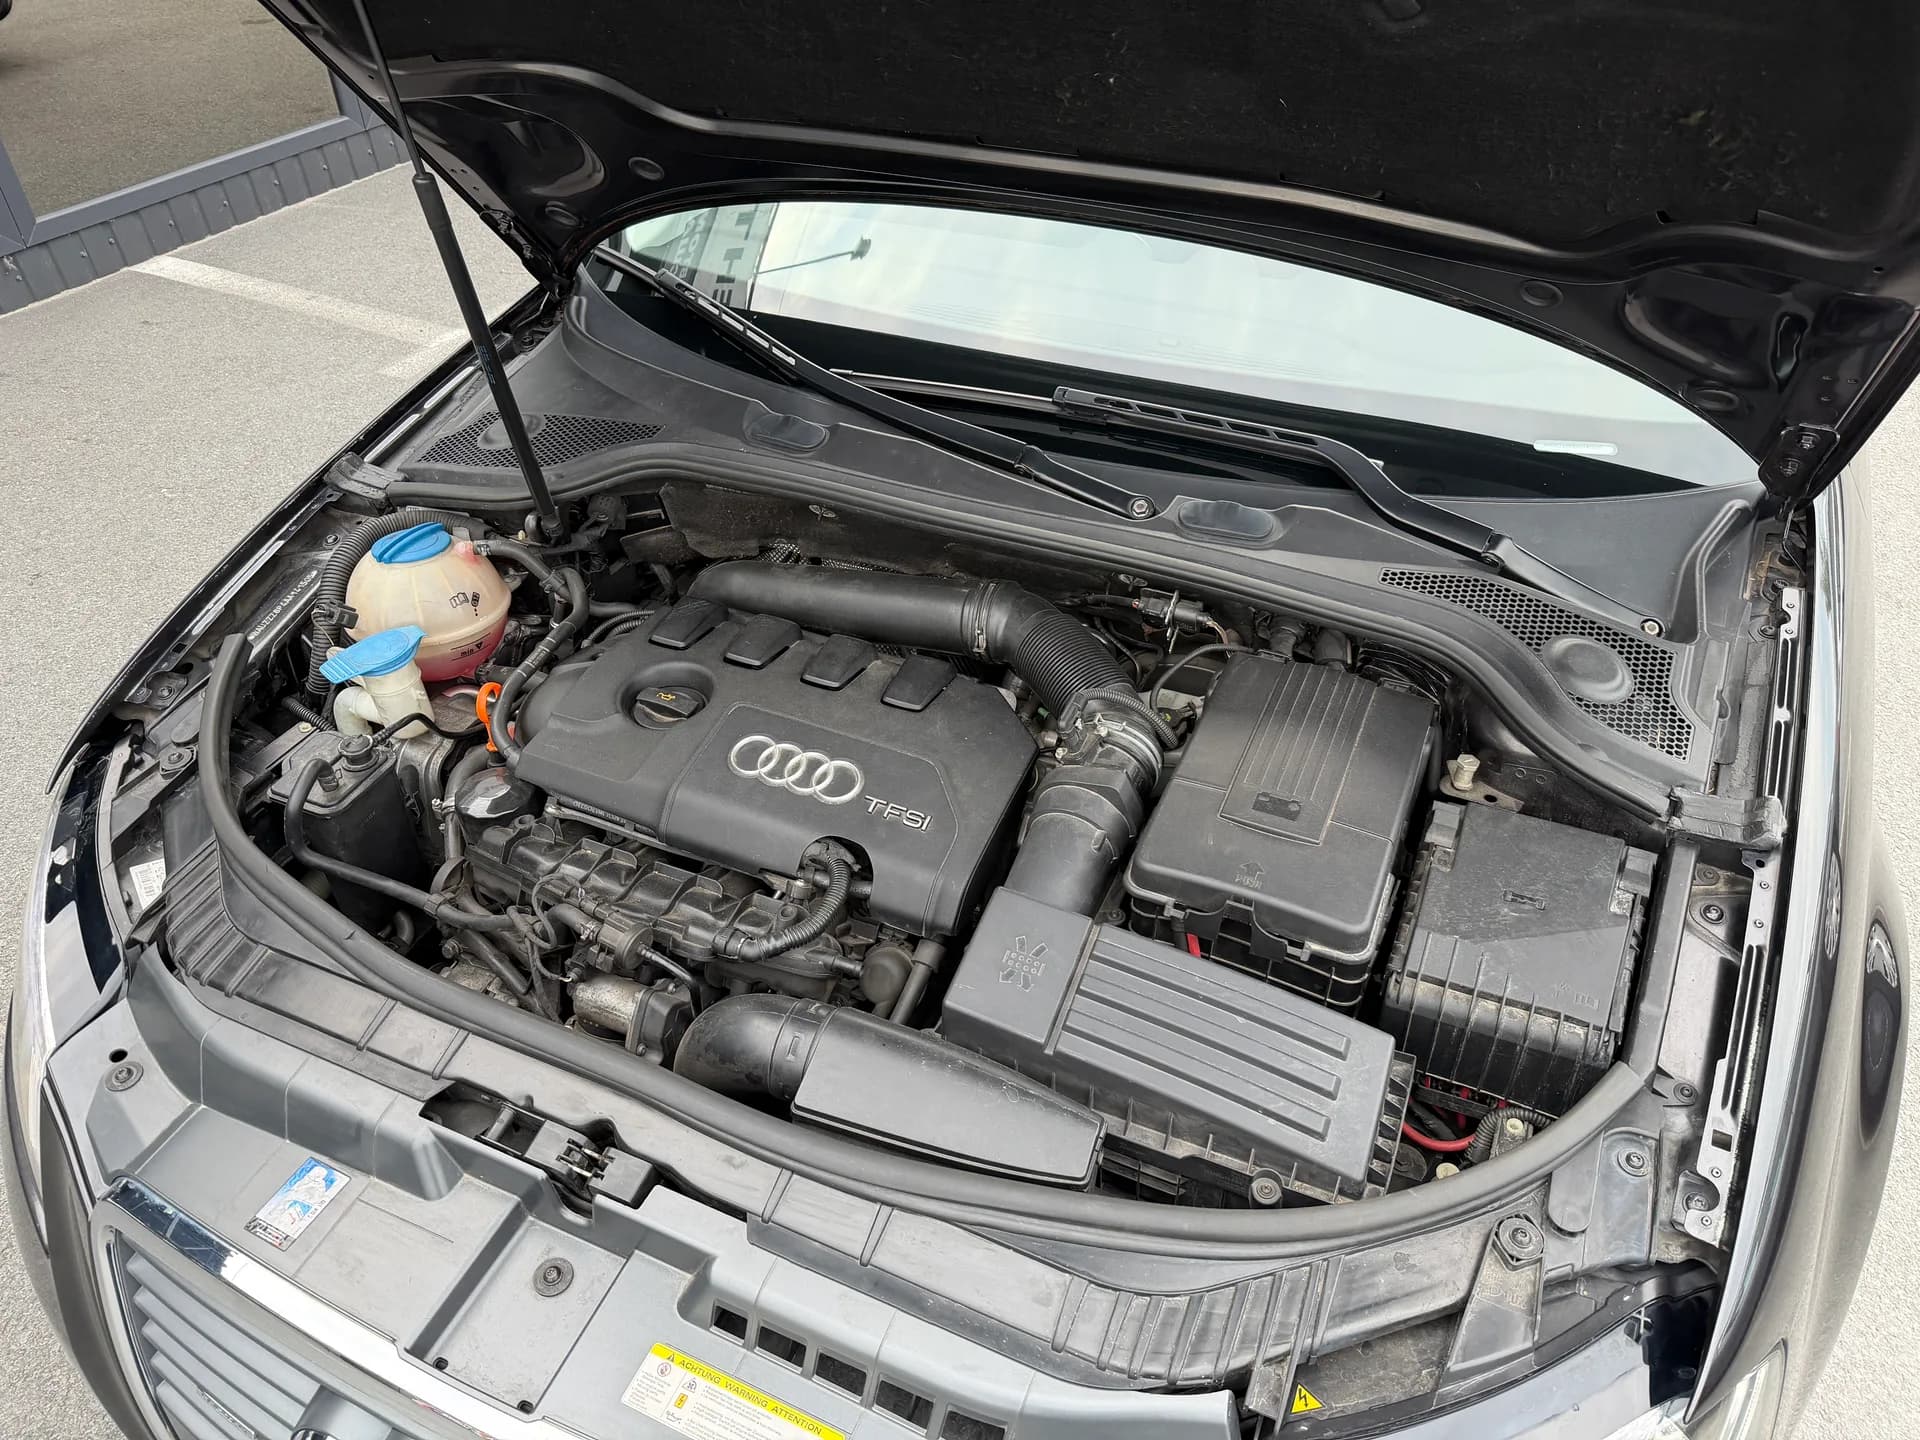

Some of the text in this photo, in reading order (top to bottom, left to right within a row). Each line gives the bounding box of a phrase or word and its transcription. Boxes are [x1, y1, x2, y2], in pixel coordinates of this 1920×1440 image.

[460, 648, 474, 657] min
[864, 795, 933, 832] TFSI
[678, 1359, 721, 1384] ACHTUNG
[725, 1381, 769, 1408] WARNING
[770, 1405, 823, 1436] ATTENTION
